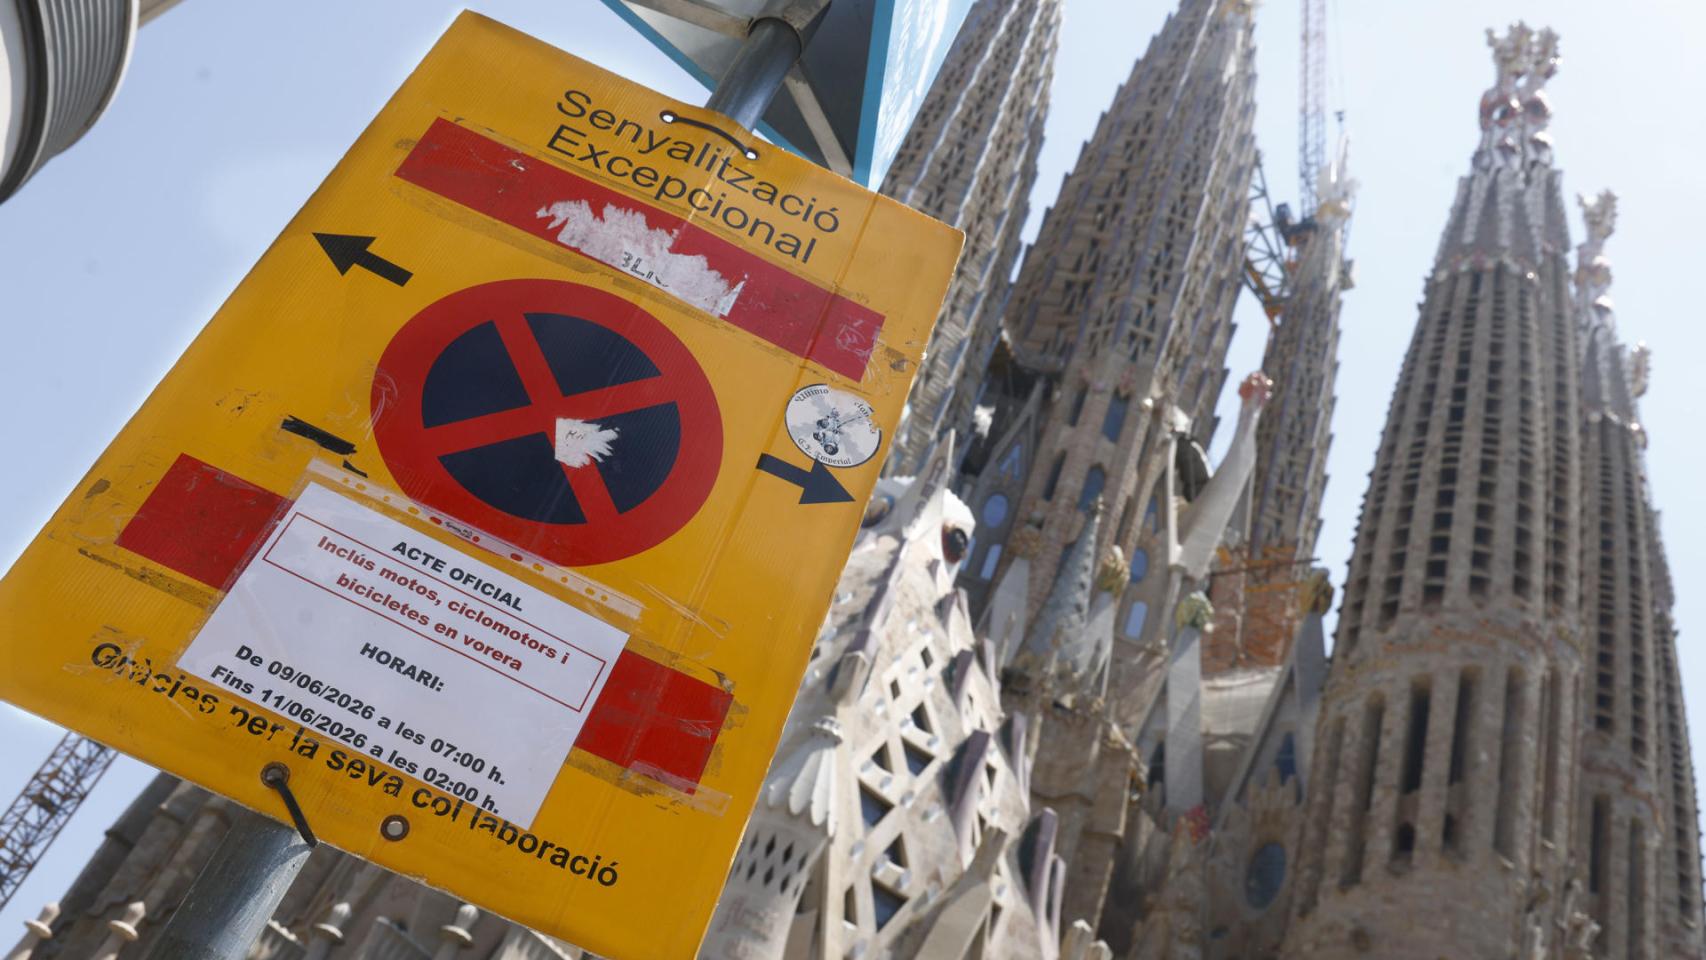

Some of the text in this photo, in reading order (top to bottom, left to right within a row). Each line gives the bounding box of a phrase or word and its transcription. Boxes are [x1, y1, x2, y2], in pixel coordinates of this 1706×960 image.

[547, 124, 816, 264] Excepcional
[557, 90, 839, 233] Senyalització
[317, 535, 570, 665] Inclús motos, ciclomotors i
[336, 573, 523, 672] bicicletes en vorera
[392, 541, 524, 612] ACTE OFICIAL
[235, 645, 506, 786] De 09/06/2026 a les 07:00 h.
[360, 643, 444, 693] HORARI:
[211, 665, 499, 814] Fins 11/06/2026 a les 02:00 h.
[327, 750, 403, 798] seva
